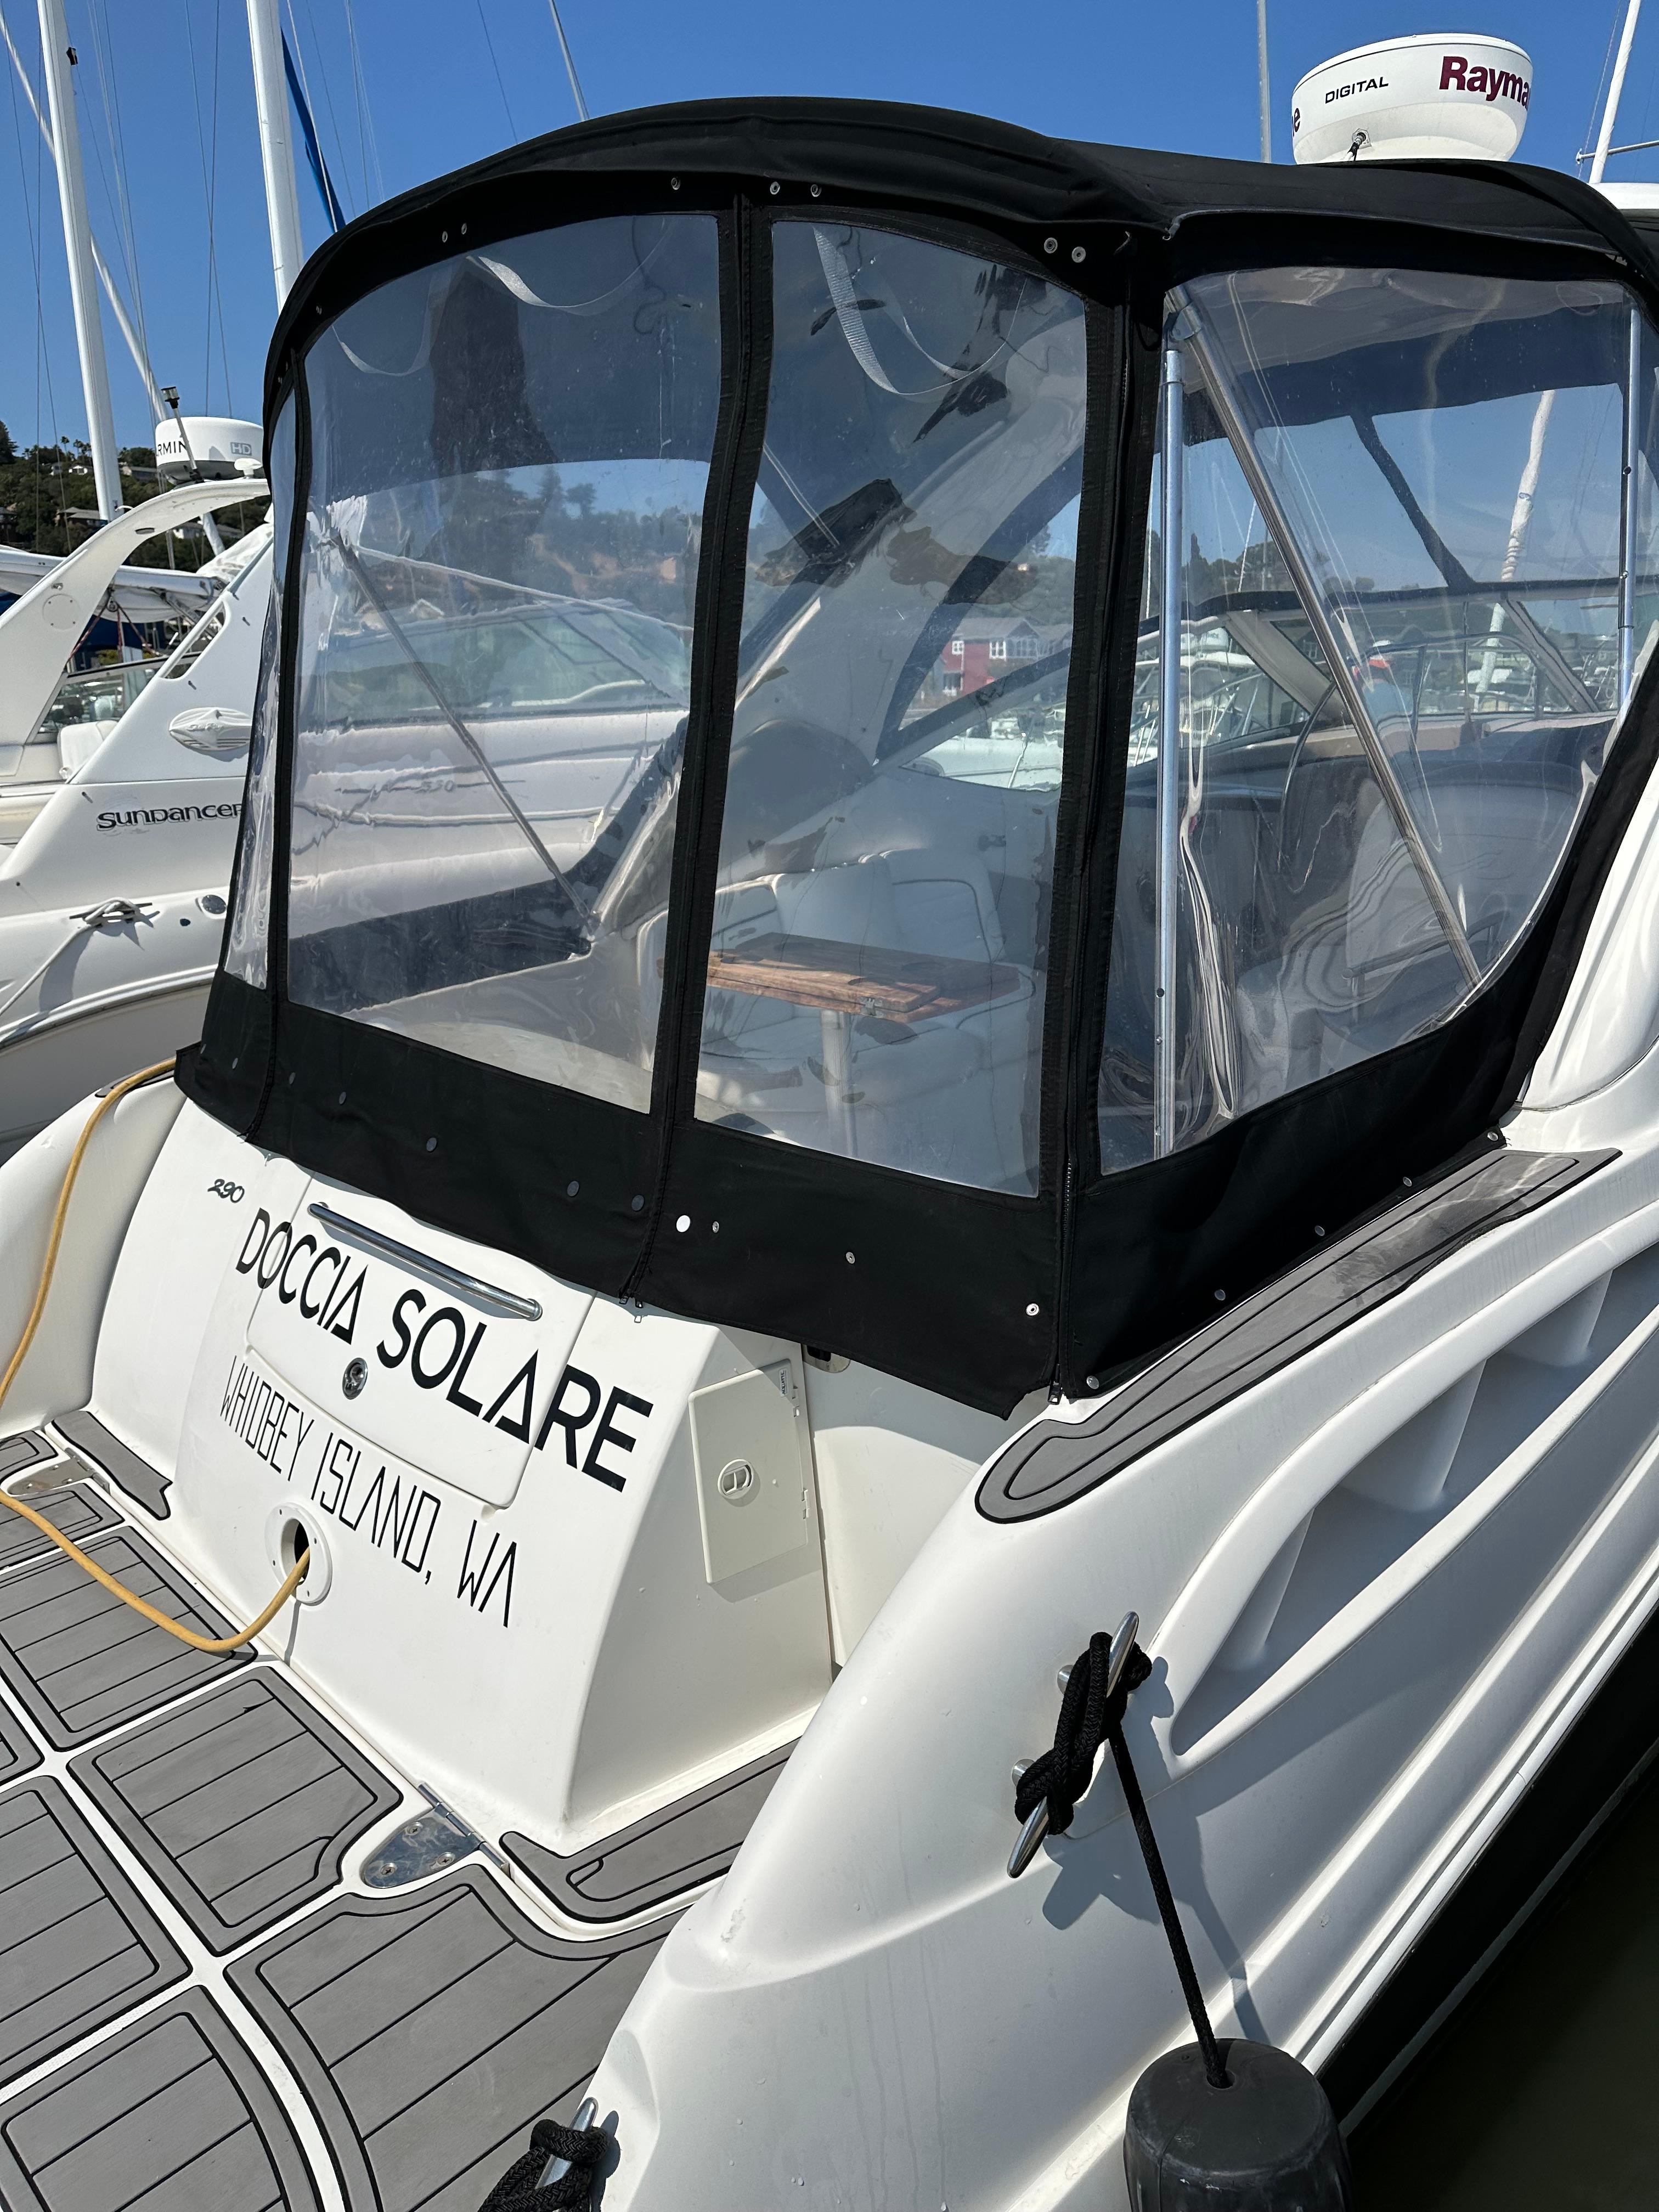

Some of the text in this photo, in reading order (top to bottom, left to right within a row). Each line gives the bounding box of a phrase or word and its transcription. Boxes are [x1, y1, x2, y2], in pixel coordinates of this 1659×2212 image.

[1325, 76, 1389, 104] DIGITAL
[1439, 55, 1531, 111] Rayma
[231, 442, 251, 455] HD
[207, 1178, 245, 1203] 290
[235, 1207, 654, 1493] DOCCIA SOLARE
[220, 1356, 517, 1628] WHIDBEY ISLAND, WA
